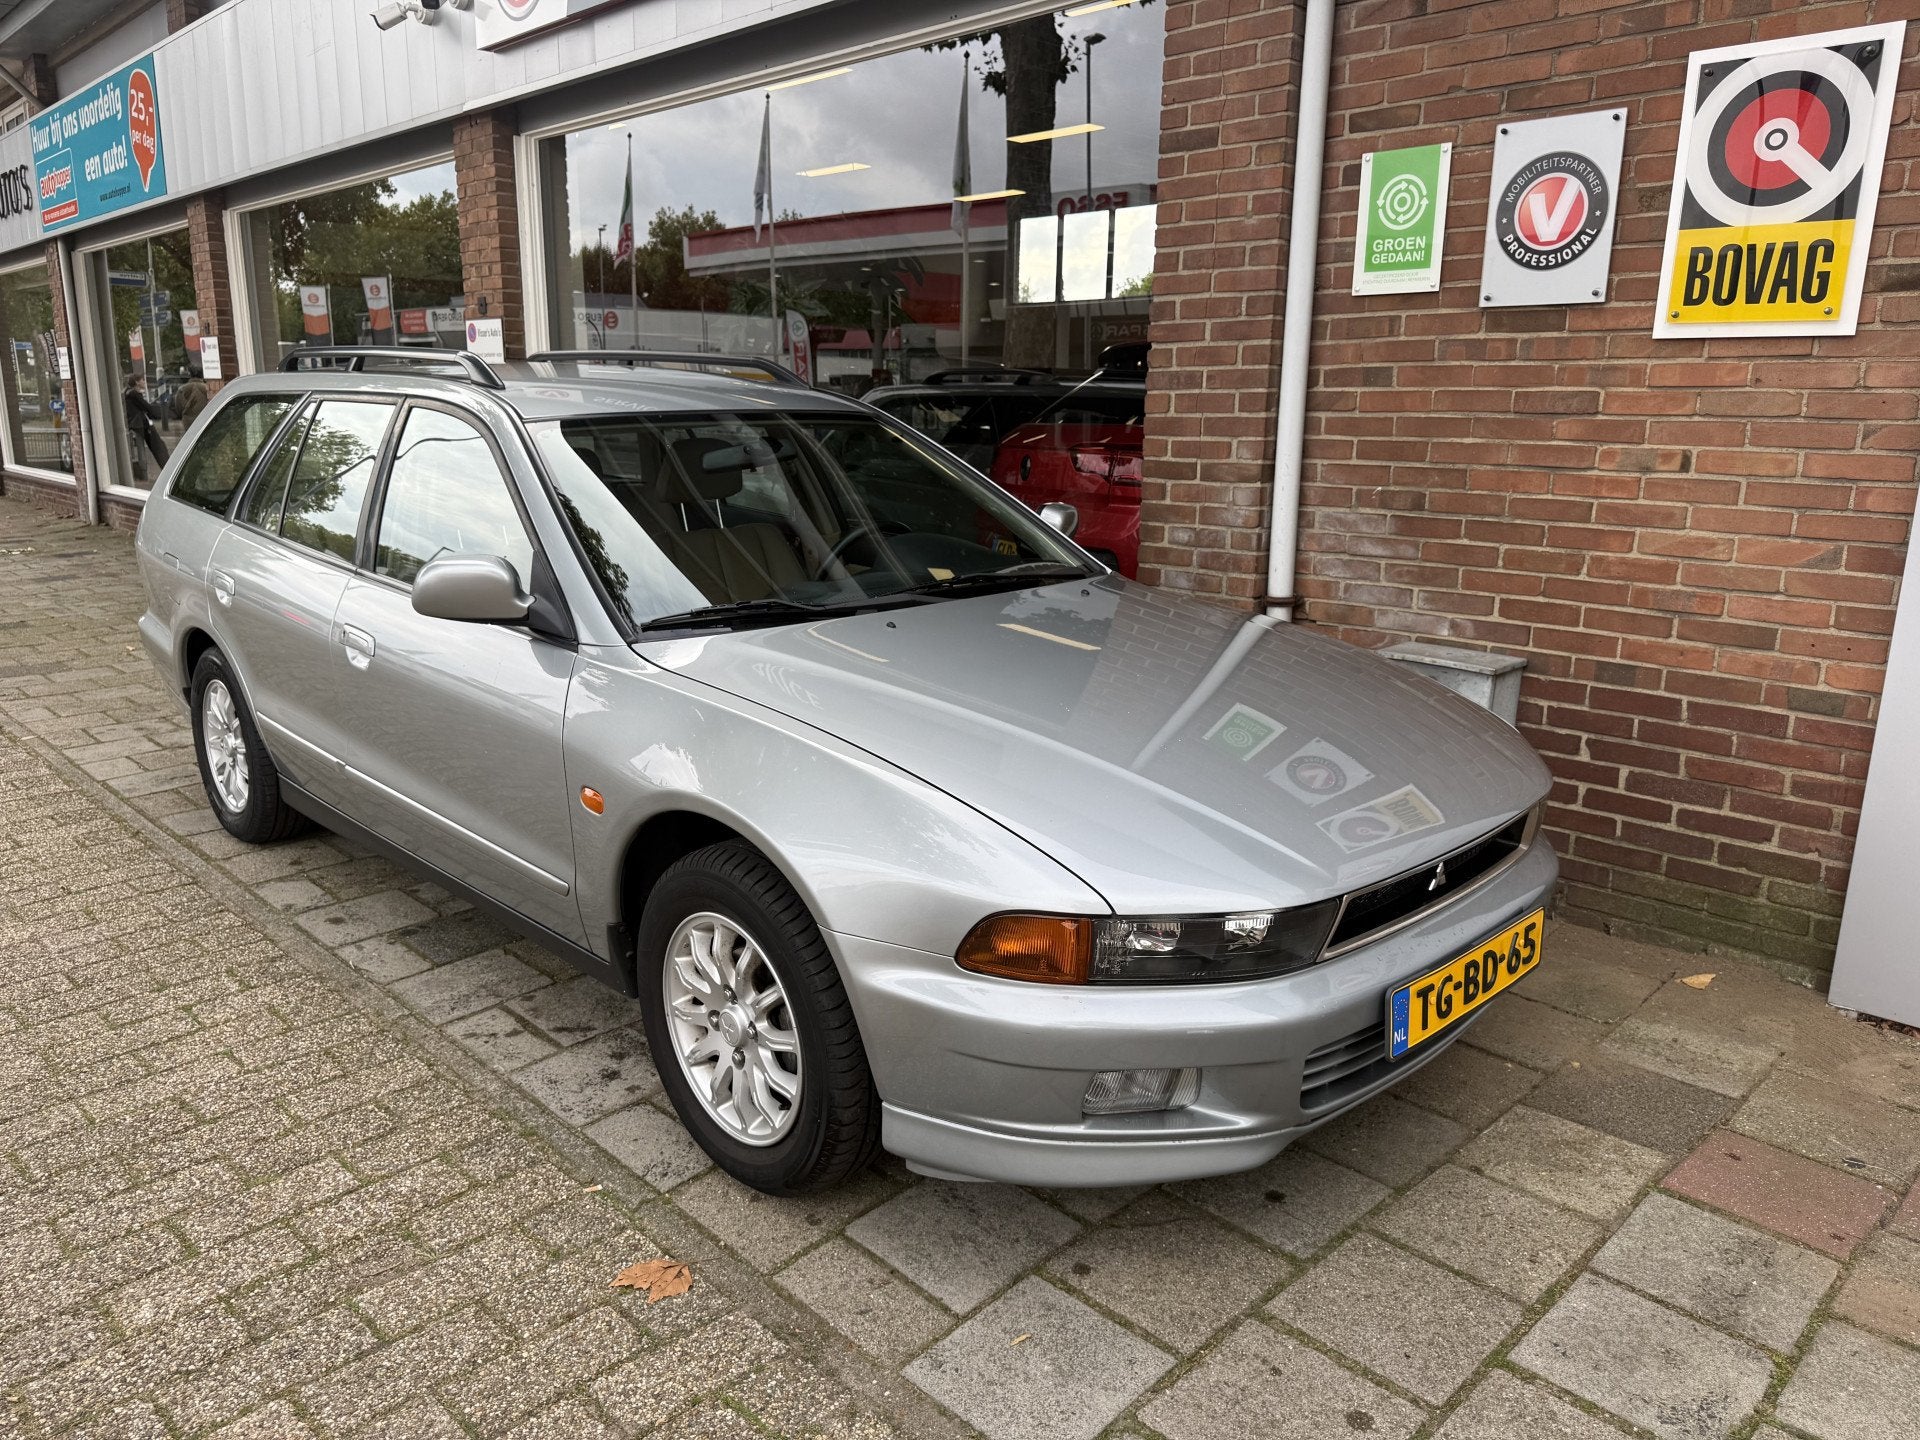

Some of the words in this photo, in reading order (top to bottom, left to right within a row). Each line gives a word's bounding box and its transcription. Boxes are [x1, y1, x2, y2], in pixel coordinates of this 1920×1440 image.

[31, 126, 50, 154] Huur
[50, 112, 63, 148] bij
[63, 111, 78, 138] ons
[78, 82, 123, 130] voordelig
[130, 89, 153, 126] 25,-
[85, 153, 102, 182] een
[102, 135, 128, 175] auto!
[131, 129, 143, 146] per
[143, 133, 154, 154] dag
[1505, 157, 1602, 203] MOBILITEITSPARTNER
[1371, 250, 1425, 264] GEDAAN!
[1372, 236, 1426, 252] GROEN
[1503, 227, 1598, 267] PROFESSIONAL
[1682, 238, 1835, 307] BOVAG
[1416, 921, 1537, 1031] TG-BD-65
[1393, 1027, 1407, 1045] NL
